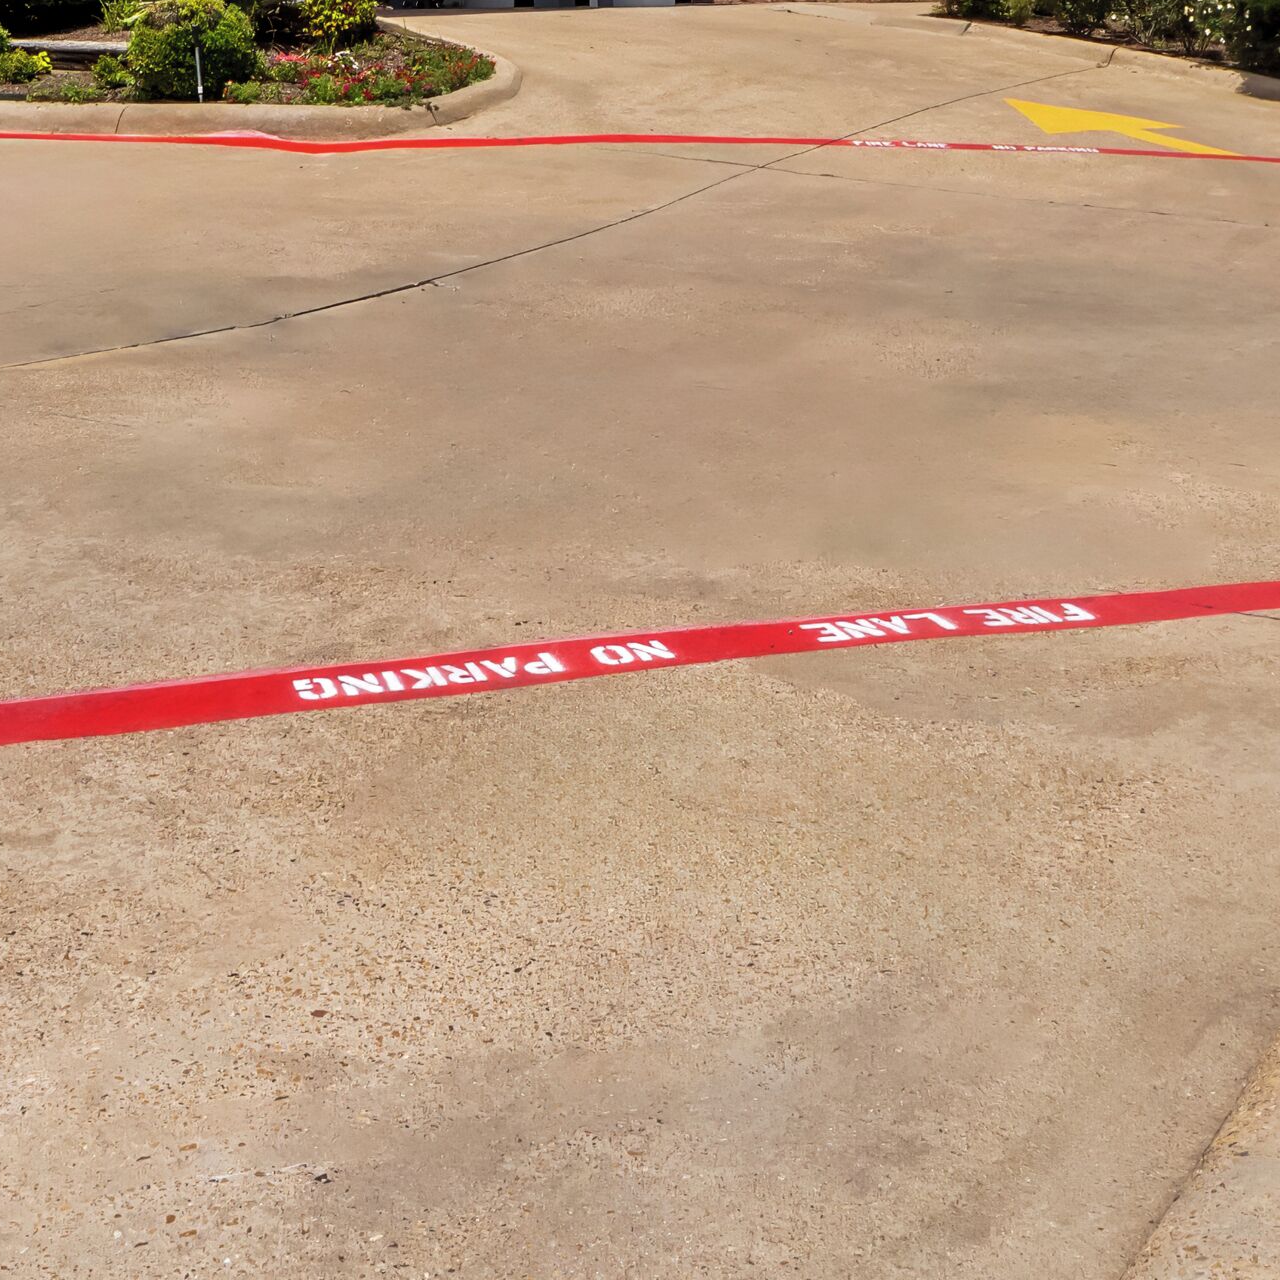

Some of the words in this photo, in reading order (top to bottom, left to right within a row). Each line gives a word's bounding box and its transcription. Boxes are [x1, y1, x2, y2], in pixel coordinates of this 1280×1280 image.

[799, 612, 958, 643] LANE
[962, 602, 1097, 627] FIRE
[590, 639, 676, 666] NO
[291, 651, 567, 701] PARKING
